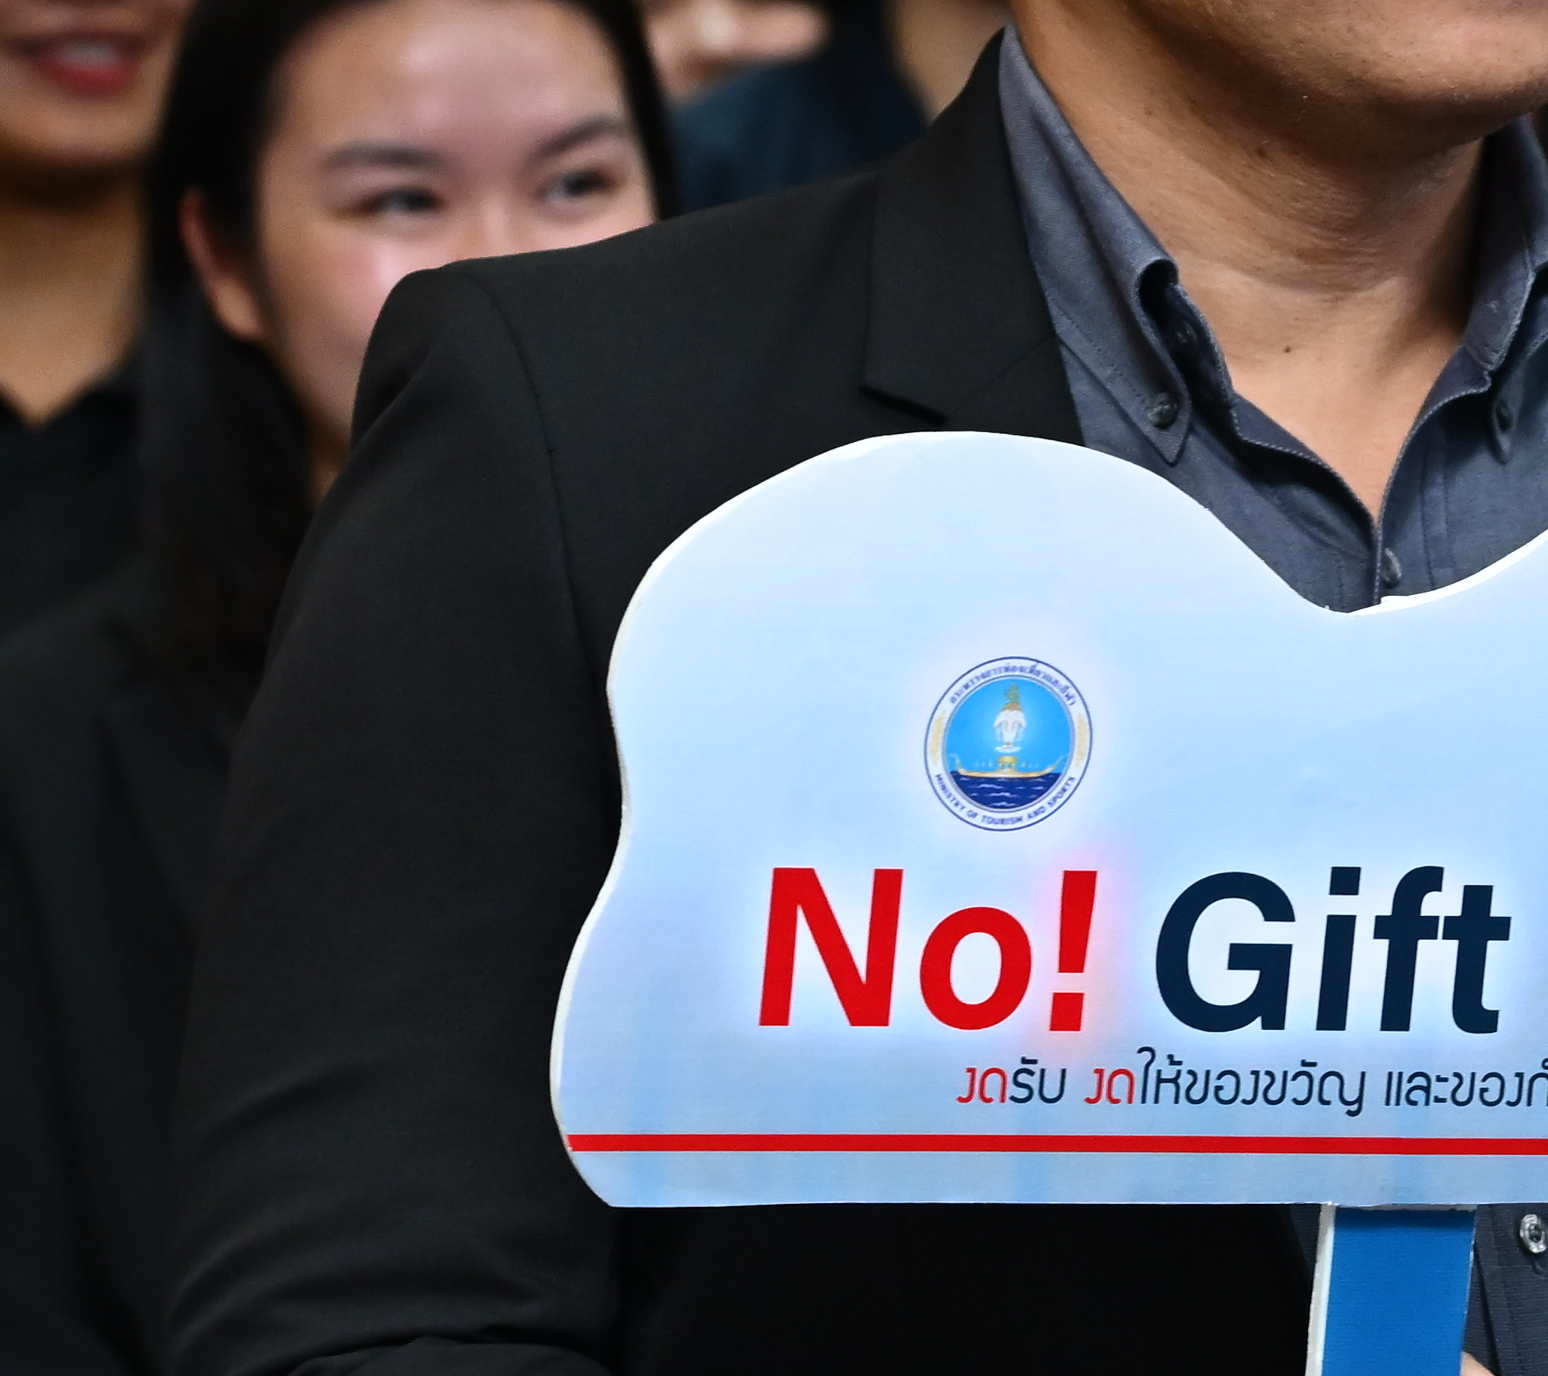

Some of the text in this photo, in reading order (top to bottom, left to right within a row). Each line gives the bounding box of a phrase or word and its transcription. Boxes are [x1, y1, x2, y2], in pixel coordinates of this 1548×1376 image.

[981, 814, 1023, 825] TOURISM
[1027, 805, 1046, 821] AND
[1047, 776, 1076, 808] SPORTS
[759, 868, 1097, 1031] No!
[1156, 866, 1511, 1035] Gift
[957, 1057, 1066, 1104] งดรับ
[1085, 1047, 1366, 1117] งดให้ของขวัญ
